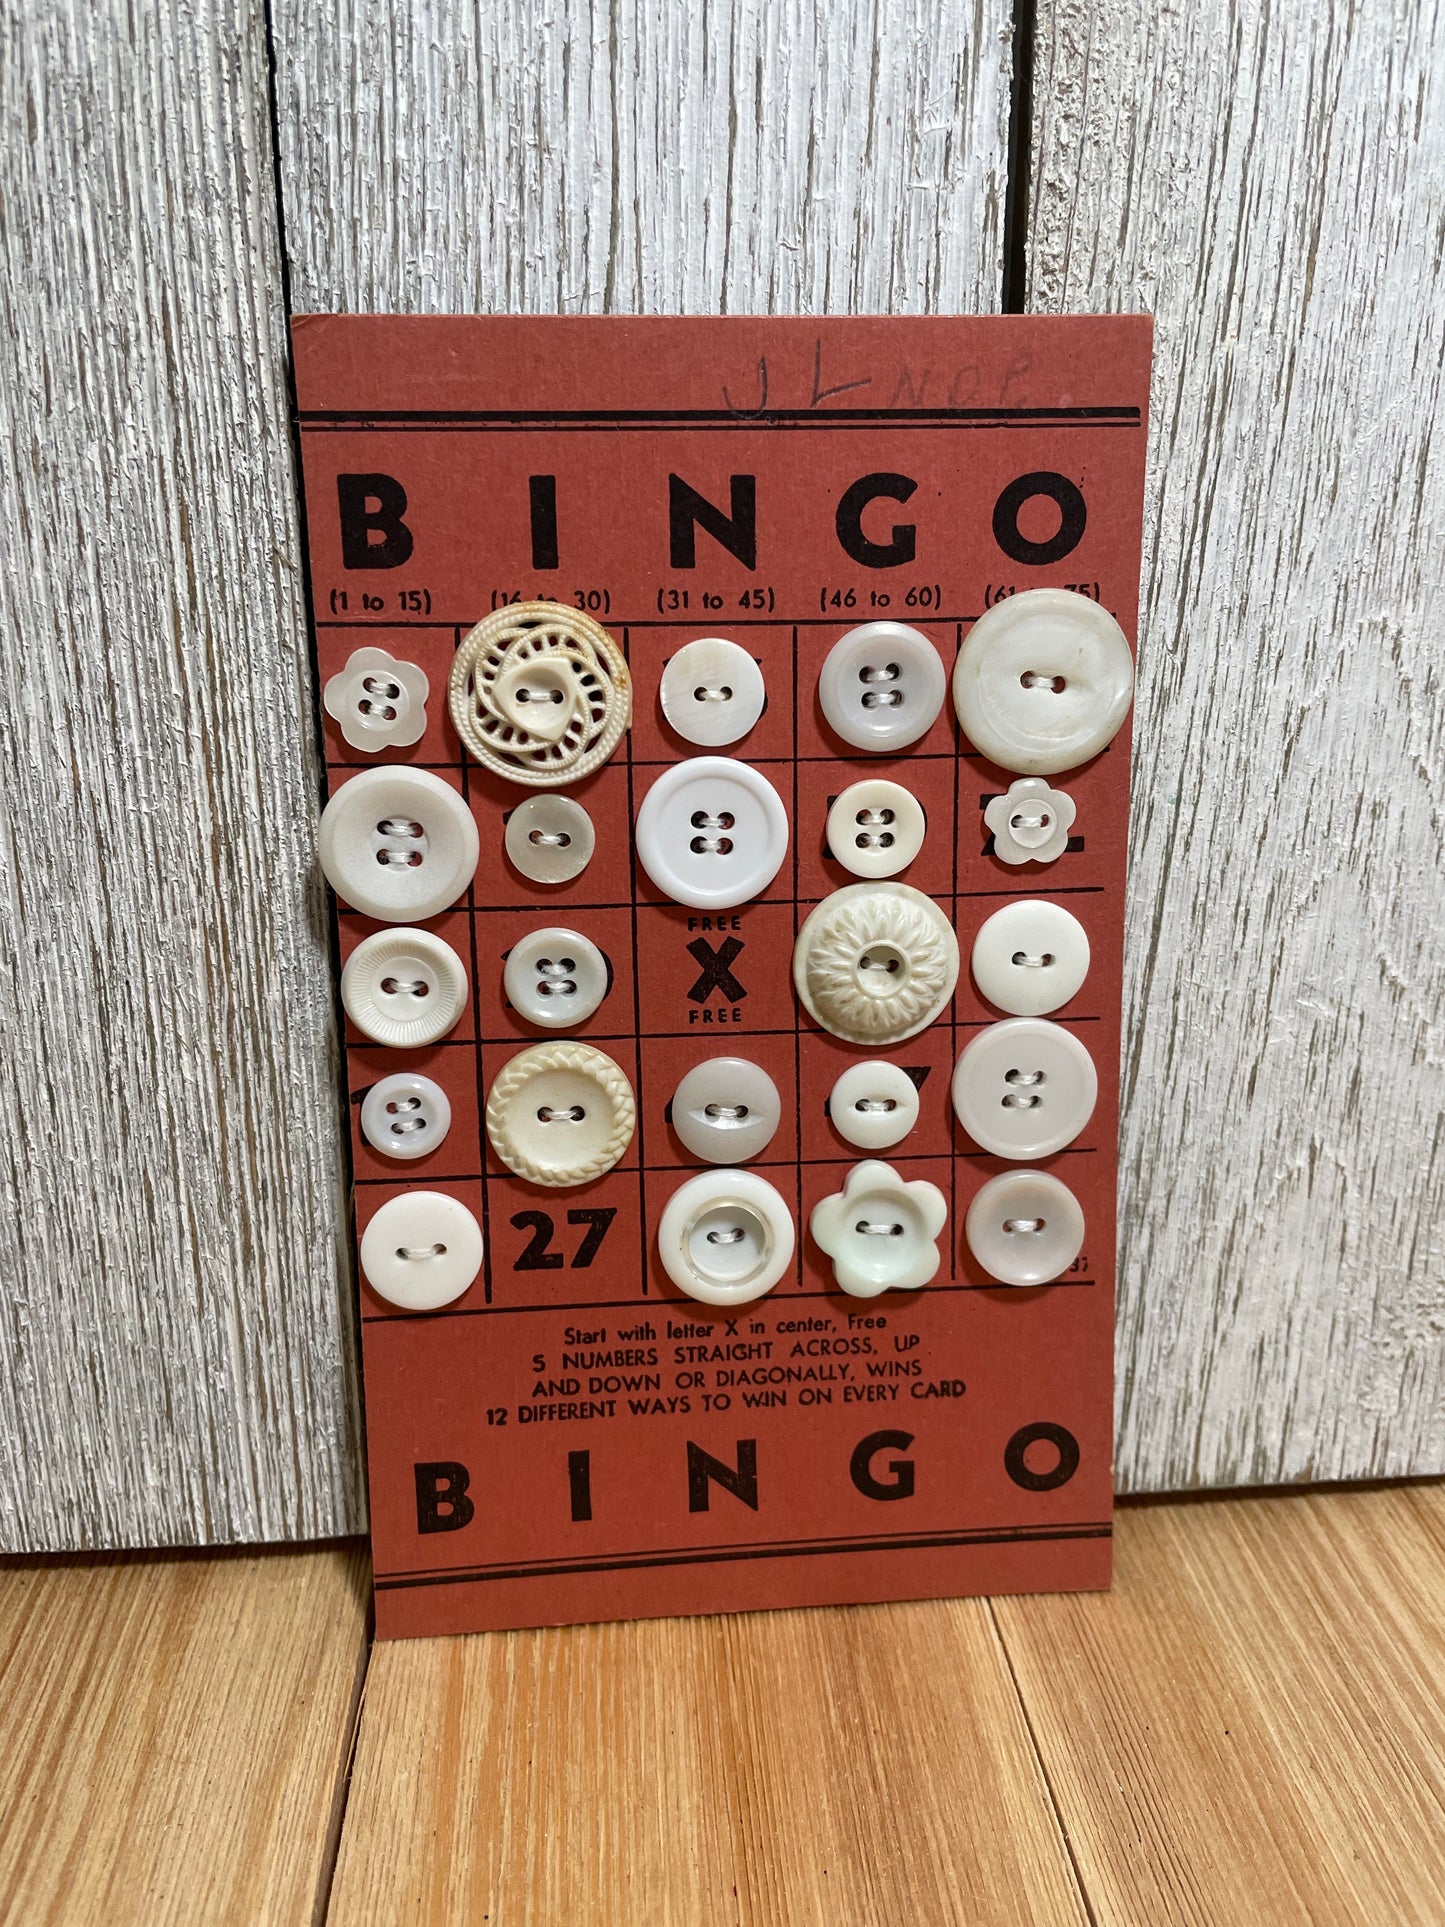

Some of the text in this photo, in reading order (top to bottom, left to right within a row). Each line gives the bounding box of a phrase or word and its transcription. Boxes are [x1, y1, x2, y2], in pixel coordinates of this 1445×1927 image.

[330, 589, 431, 615] (1 to 15)
[574, 589, 610, 614] 30)
[658, 588, 774, 613] (31 to 45)
[821, 585, 940, 613] (46 to 60)
[688, 917, 742, 931] FREE
[686, 936, 747, 1004] X
[689, 1008, 742, 1024] FREE
[510, 1207, 617, 1271] 27
[564, 1313, 888, 1345] Start with letter X in center, Free
[533, 1334, 920, 1373] 5 NUMBERS STRAIGHT ACROSS, UP
[532, 1359, 922, 1398] AND DOWN OR DIAGONALLY, WINS
[487, 1379, 967, 1426] 12 DIFFERENT WAYS TO WIN ON EVERY CARD
